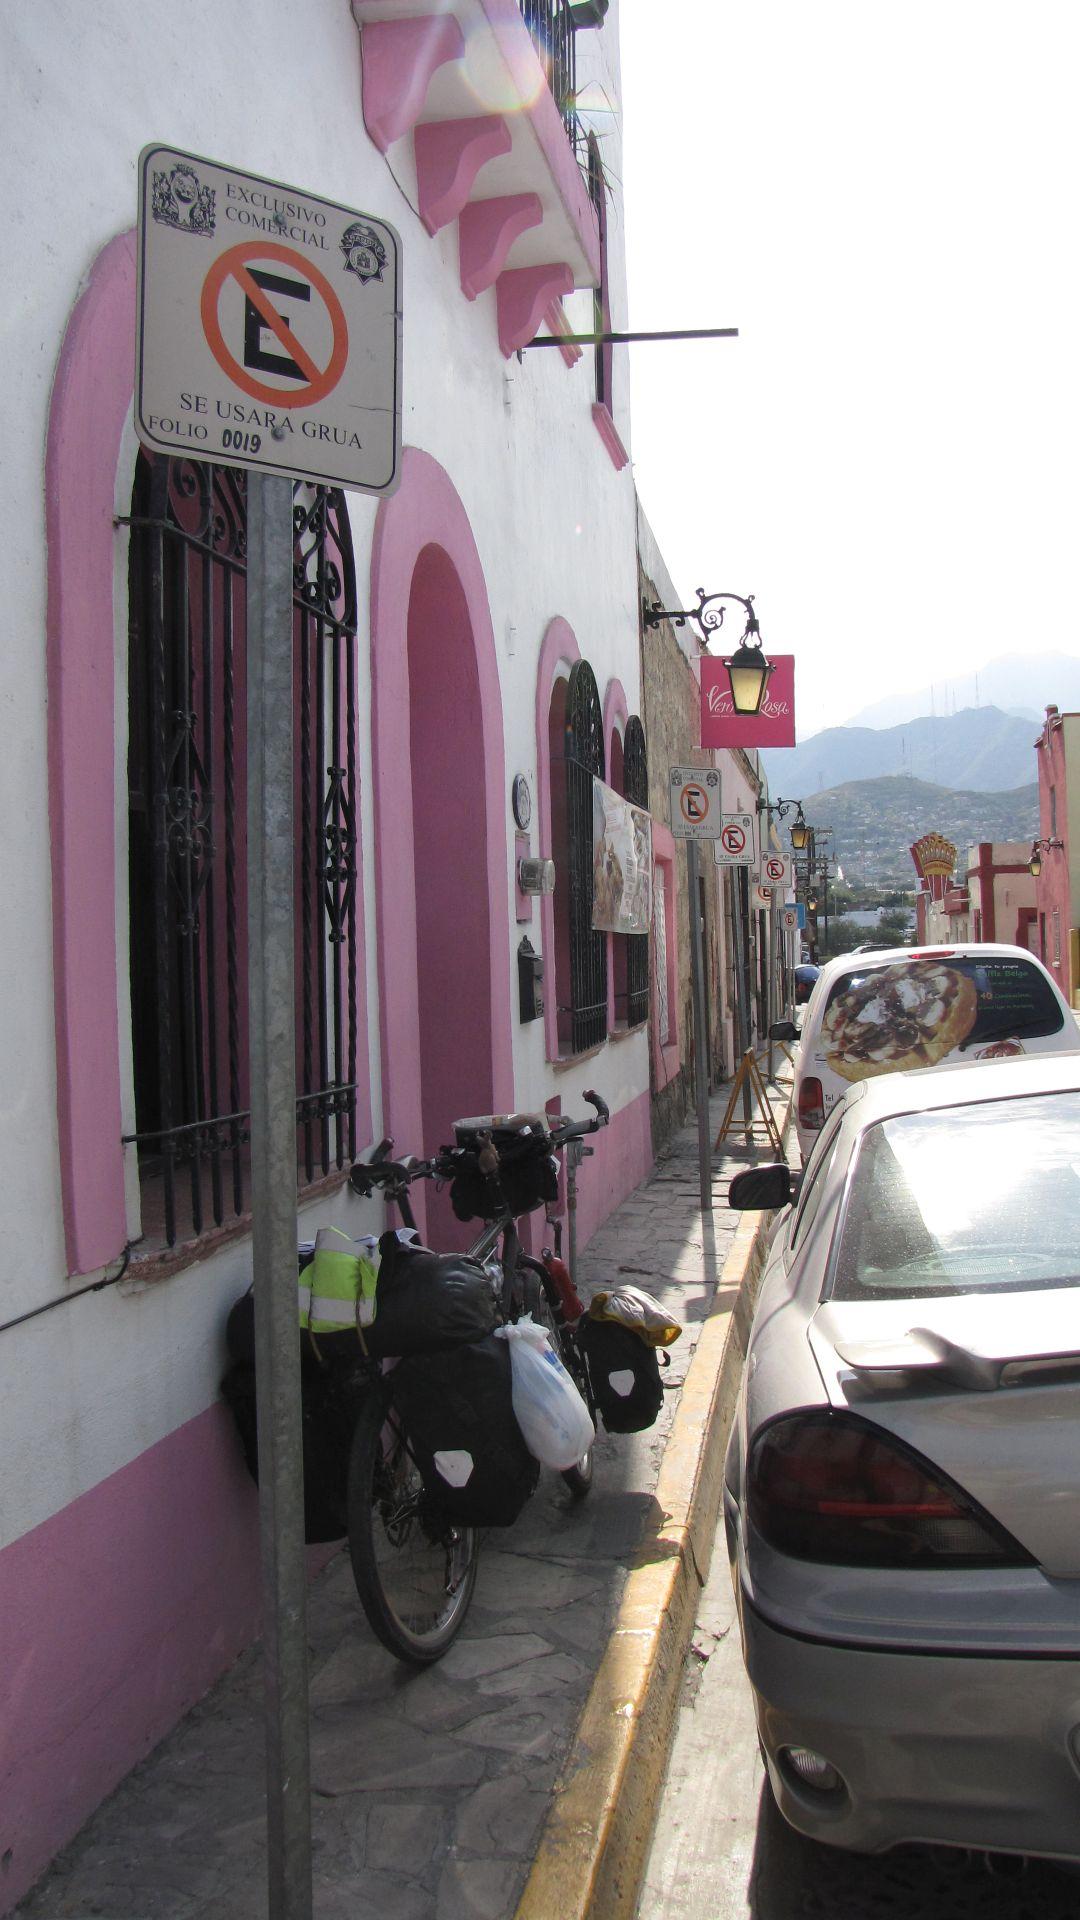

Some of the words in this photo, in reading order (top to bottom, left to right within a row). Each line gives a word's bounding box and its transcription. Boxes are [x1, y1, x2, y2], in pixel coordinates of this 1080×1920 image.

[226, 183, 327, 227] EXCLUSIVO
[225, 206, 329, 250] COMERCIAL
[148, 414, 208, 440] FOLIO
[222, 429, 262, 454] 0019
[180, 393, 208, 414] SE
[216, 400, 295, 433] USARA
[302, 421, 362, 449] GRUA
